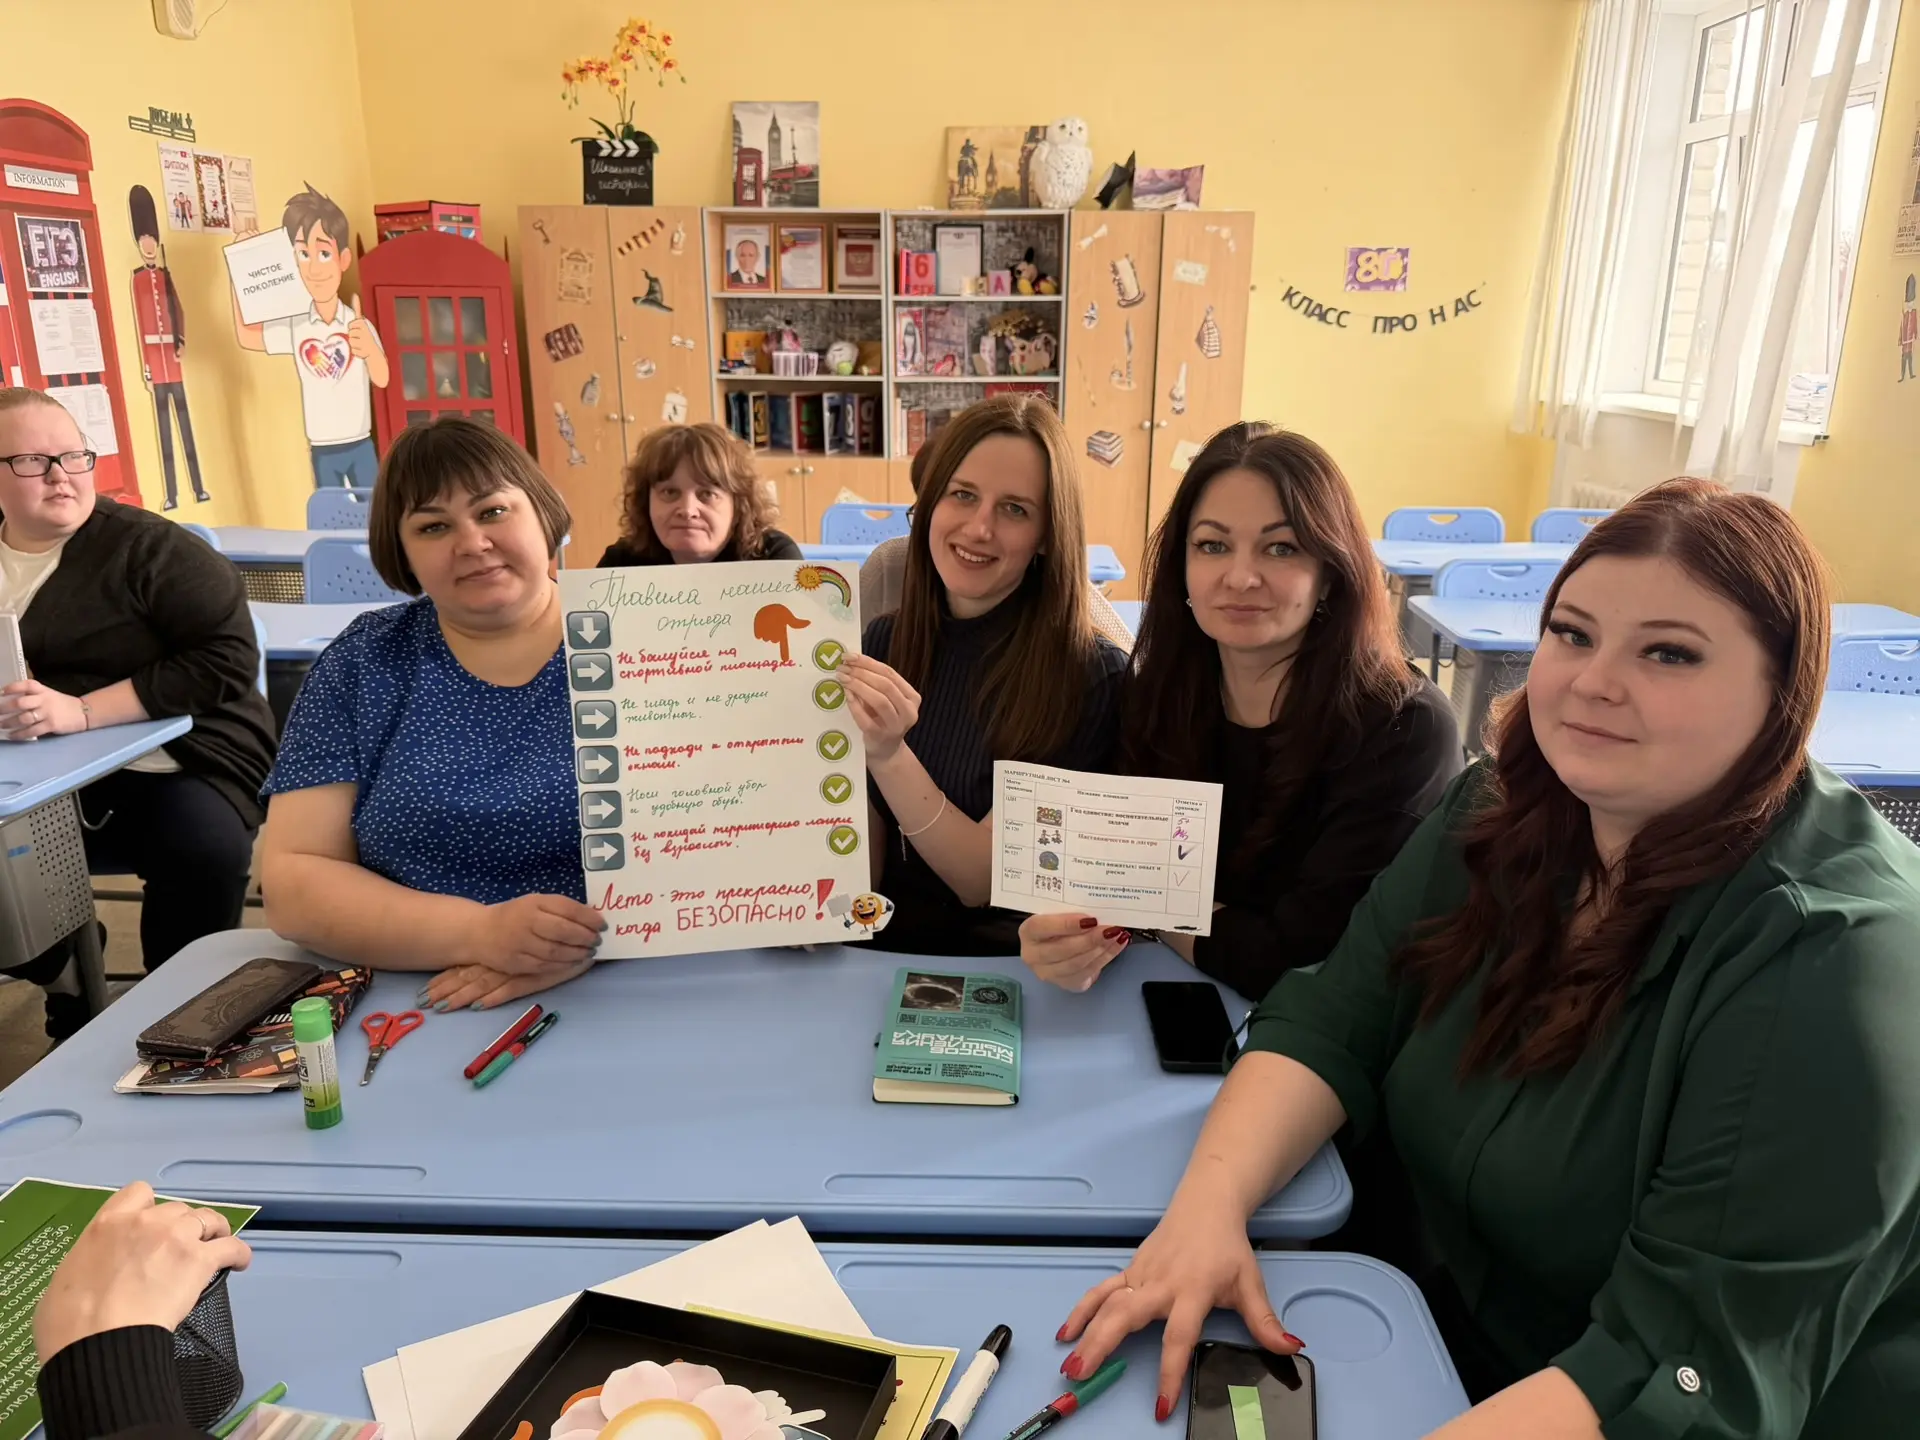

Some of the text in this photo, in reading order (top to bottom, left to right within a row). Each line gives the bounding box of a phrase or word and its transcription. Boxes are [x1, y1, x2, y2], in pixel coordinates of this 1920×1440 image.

[14, 172, 66, 188] INFORMATION
[27, 223, 79, 267] ЕГЭ
[248, 263, 283, 278] ЧИСТОЕ
[915, 254, 929, 278] 6
[39, 271, 79, 287] ENGLISH
[243, 273, 296, 296] ПОКОЛЕНИЕ
[1281, 285, 1351, 329] КЛАСС
[1372, 314, 1418, 334] ПРО
[587, 570, 802, 627] Правила нашего
[657, 613, 732, 640] отряда
[617, 646, 737, 668] Не балуйся на
[619, 662, 713, 683] спортивной
[621, 690, 769, 716] Не гладь и не дразни
[624, 708, 702, 723] животных.
[623, 745, 640, 758] Не
[644, 743, 703, 759] подходи
[1004, 770, 1045, 780] МАРШРУТНЫЙ
[626, 780, 767, 801] Носи головной убор
[651, 798, 703, 818] удобную
[631, 830, 648, 842] Не
[653, 824, 706, 843] покидай
[713, 819, 800, 836] территорию
[634, 846, 651, 863] без
[592, 883, 653, 911] Лето
[670, 889, 705, 902] это
[715, 881, 816, 904] прекрасно,
[615, 921, 662, 943] когда
[893, 1029, 964, 1042] НАУКА
[892, 1038, 1014, 1057] МЫШЛЕНИЯ
[929, 1046, 1014, 1065] СПОСОБ
[0, 1261, 30, 1287] ремя
[36, 1223, 73, 1251] 08.30.
[4, 1260, 14, 1268] в
[14, 1226, 54, 1259] лагере
[0, 1234, 76, 1297] воспитателя.
[3, 1265, 60, 1310] головной
